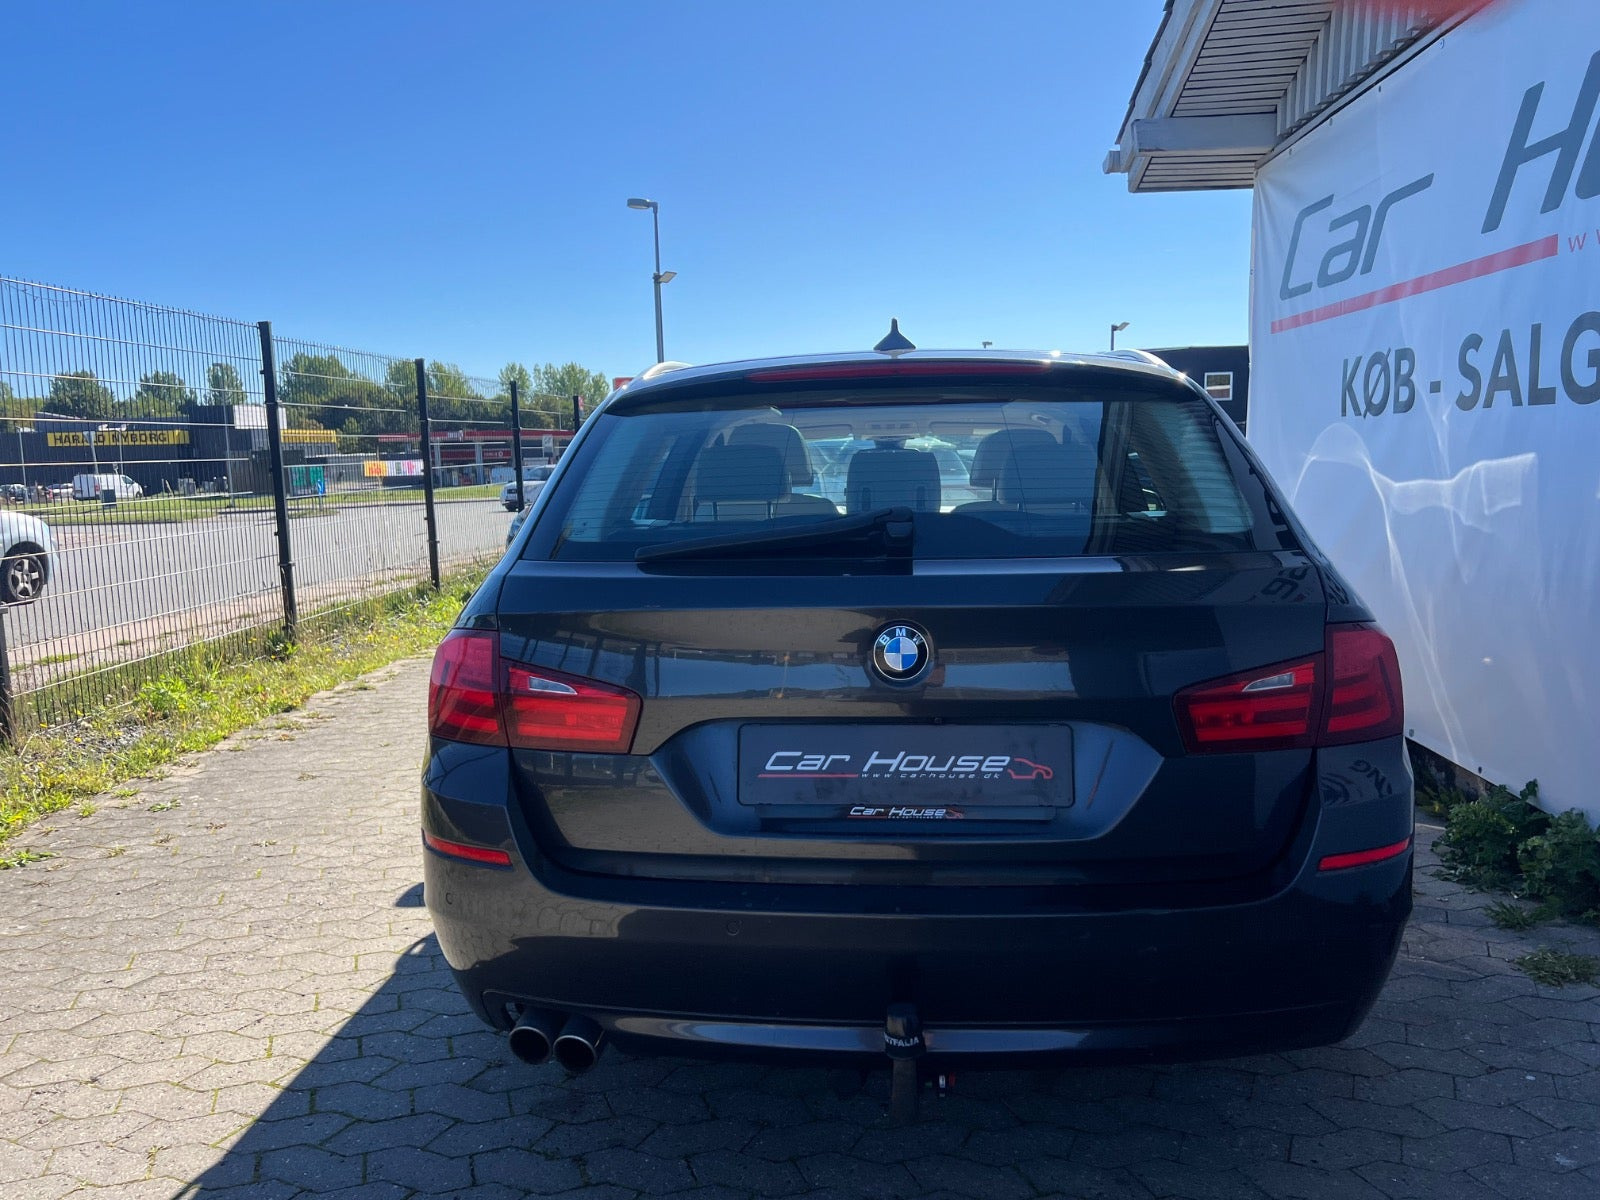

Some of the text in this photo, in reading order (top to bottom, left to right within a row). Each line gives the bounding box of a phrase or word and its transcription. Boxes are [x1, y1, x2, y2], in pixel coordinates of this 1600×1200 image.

[1280, 173, 1434, 300] Car
[1341, 347, 1415, 419] KØB
[1456, 311, 1600, 411] SALG
[54, 432, 168, 444] HARAD NYBORG
[879, 627, 925, 646] BMW
[764, 750, 1011, 773] Car House
[849, 806, 946, 817] Car House
